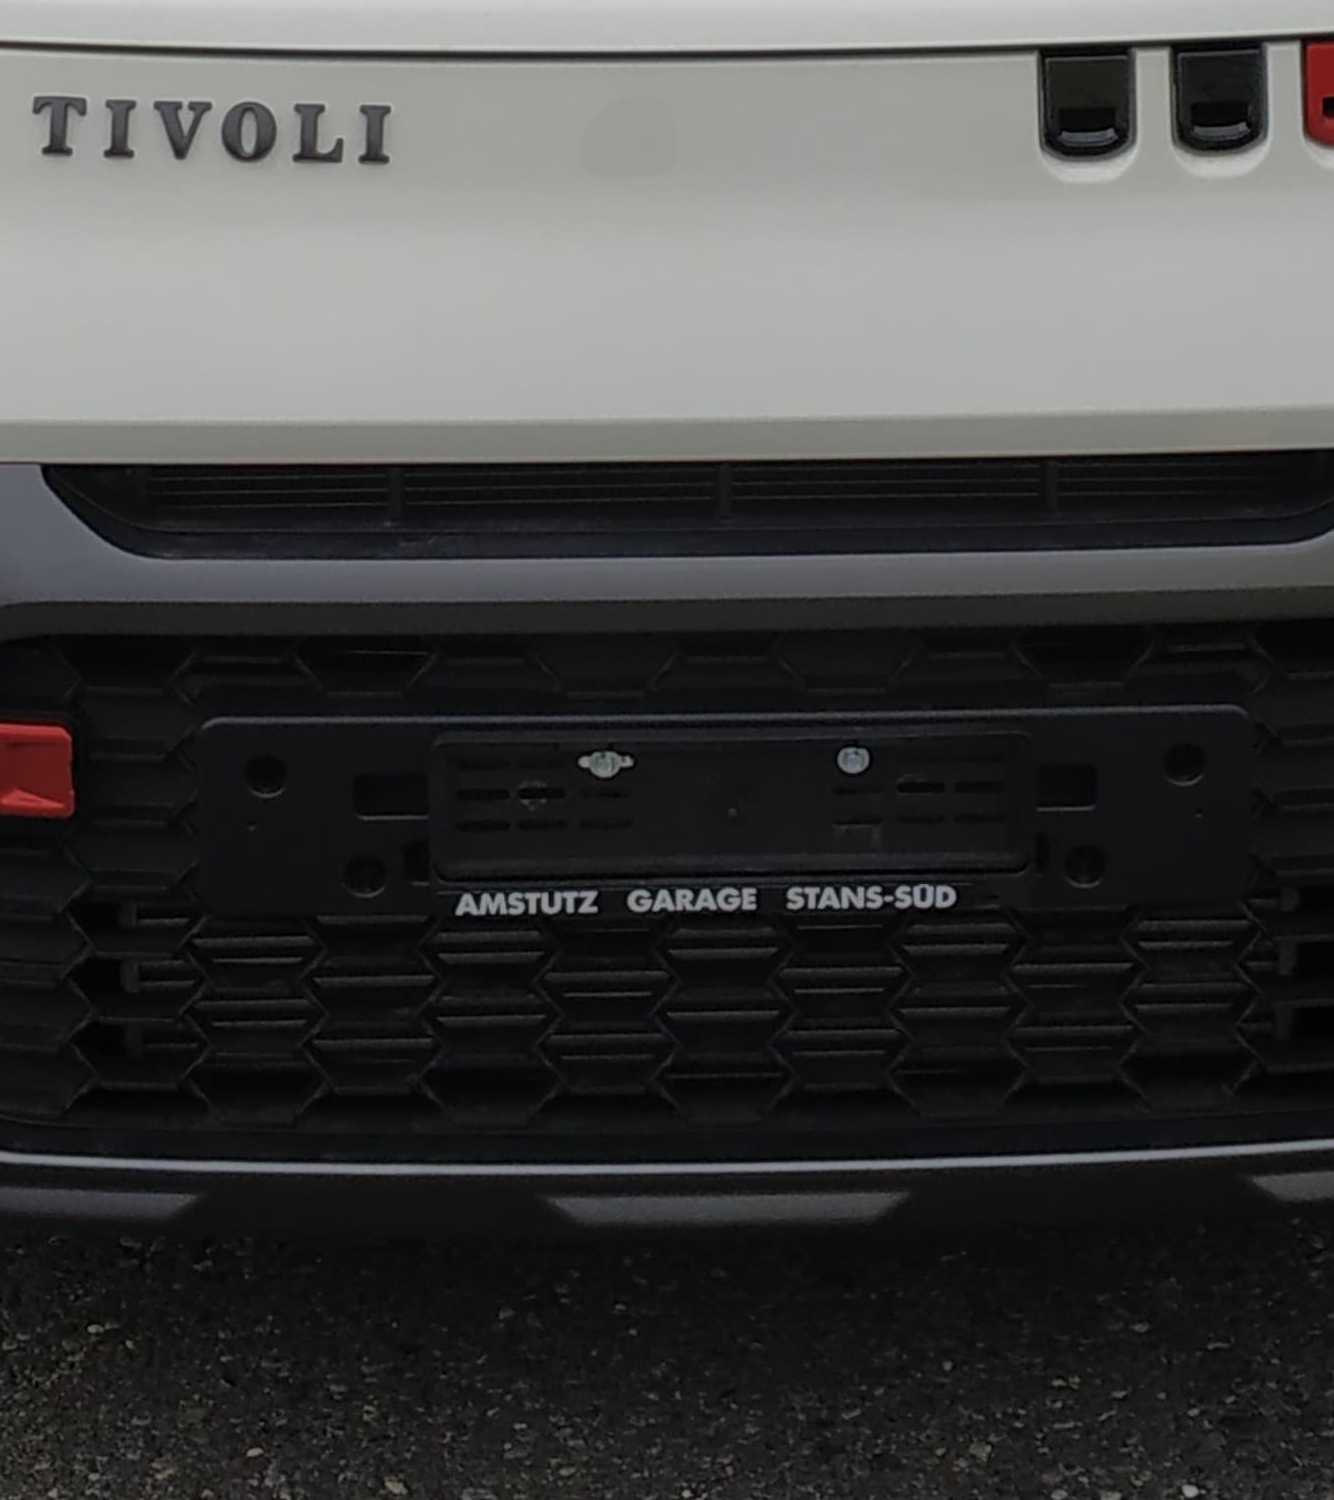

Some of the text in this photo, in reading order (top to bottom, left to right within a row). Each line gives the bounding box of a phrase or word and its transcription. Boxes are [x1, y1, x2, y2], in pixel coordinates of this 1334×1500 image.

[32, 95, 392, 165] TIVOLI
[455, 883, 957, 916] AMSTUTZ GARAGE STANS-SÜD
